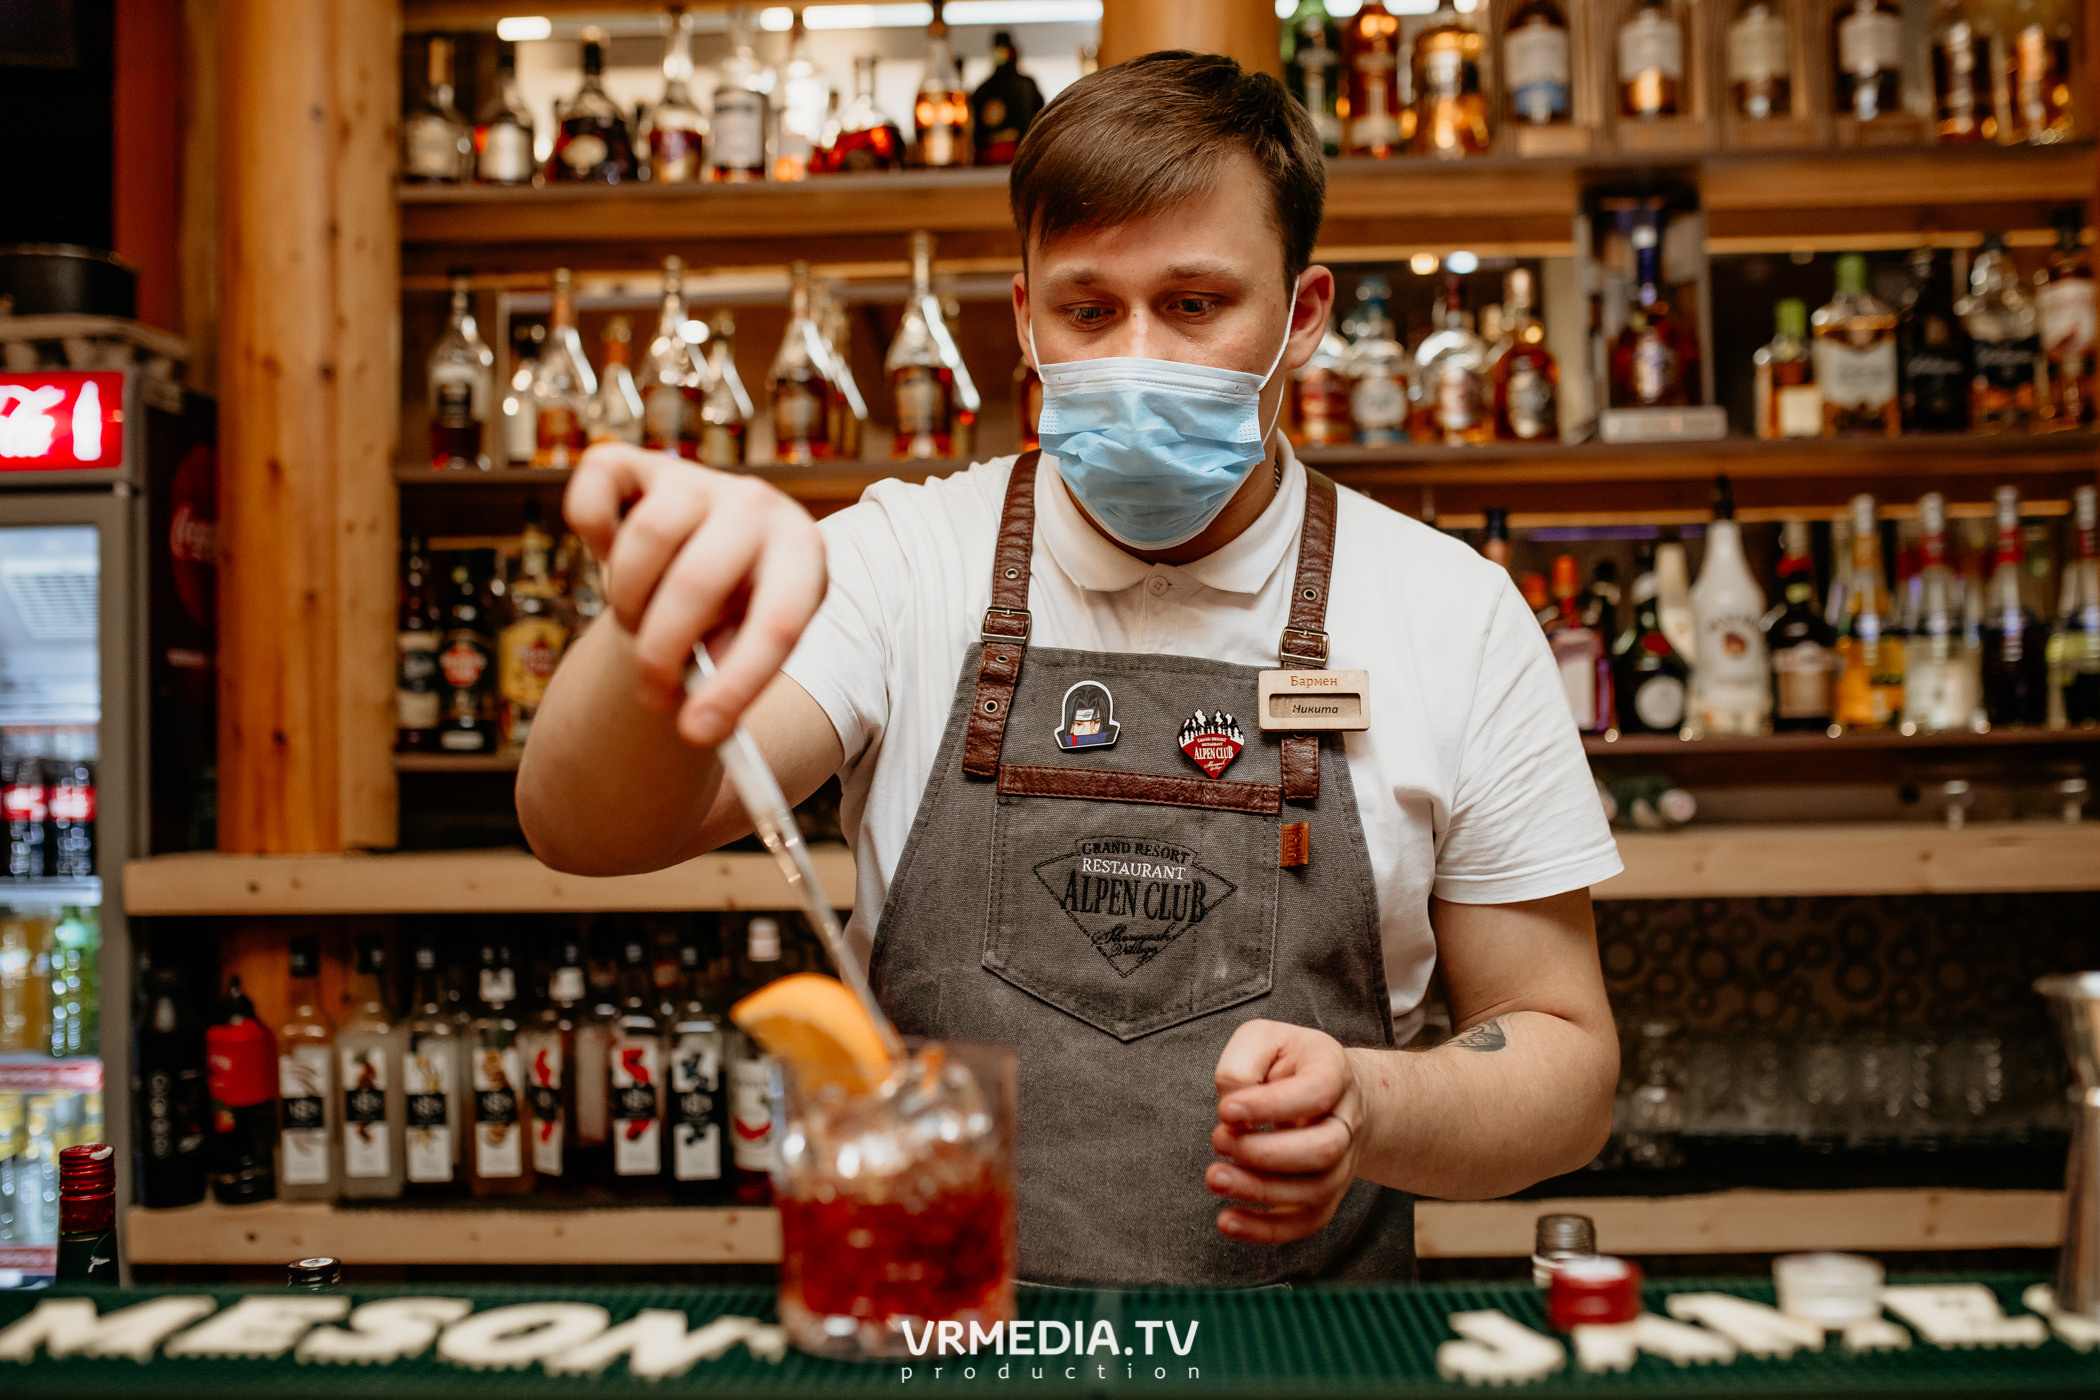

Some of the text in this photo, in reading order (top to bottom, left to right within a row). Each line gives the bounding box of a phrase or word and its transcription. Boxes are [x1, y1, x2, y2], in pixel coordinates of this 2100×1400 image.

[1290, 675, 1338, 688] Бармен
[1292, 704, 1339, 714] Никита
[1194, 745, 1234, 760] ALPEN CLUB
[1081, 841, 1192, 864] GRAND RESORT
[1082, 857, 1187, 880] RESTAURANT
[1060, 868, 1208, 924] ALPEN CLUB
